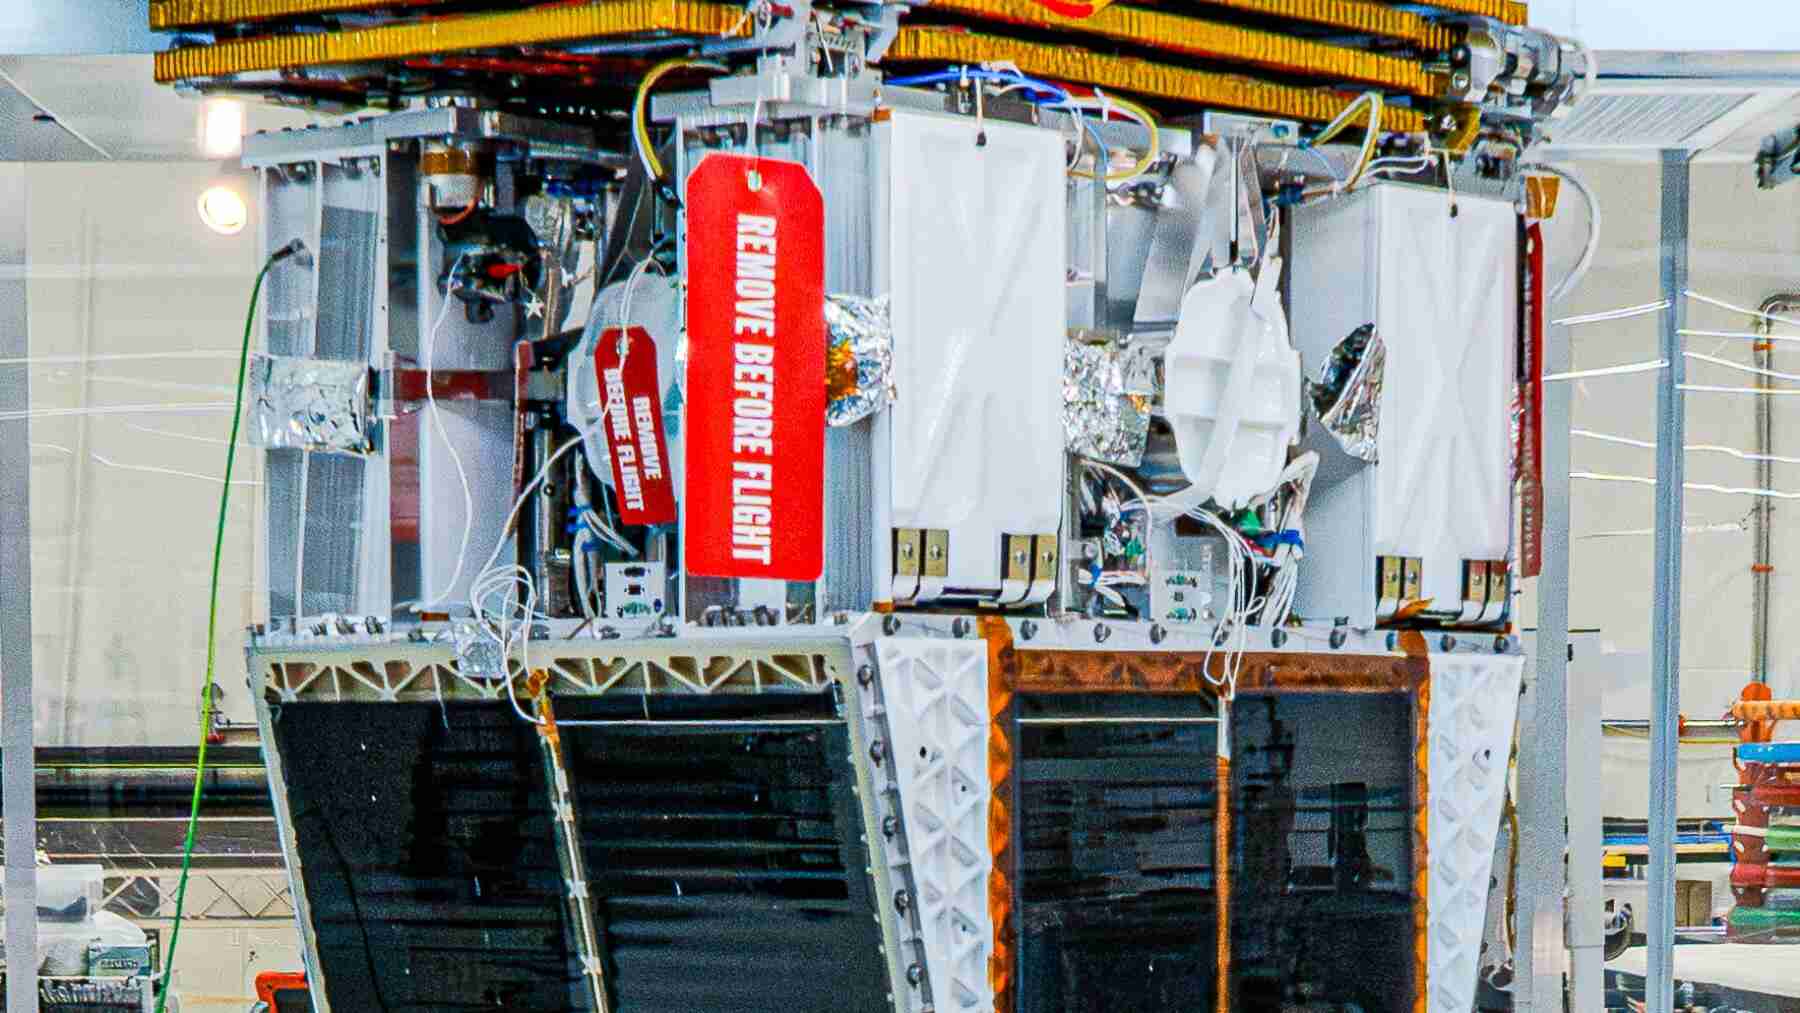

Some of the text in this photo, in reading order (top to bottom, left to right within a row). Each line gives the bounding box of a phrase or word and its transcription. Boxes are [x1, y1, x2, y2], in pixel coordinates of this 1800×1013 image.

[617, 445, 644, 511] FLIGHT
[732, 214, 777, 565] REMOVE BEFORE FLIGHT
